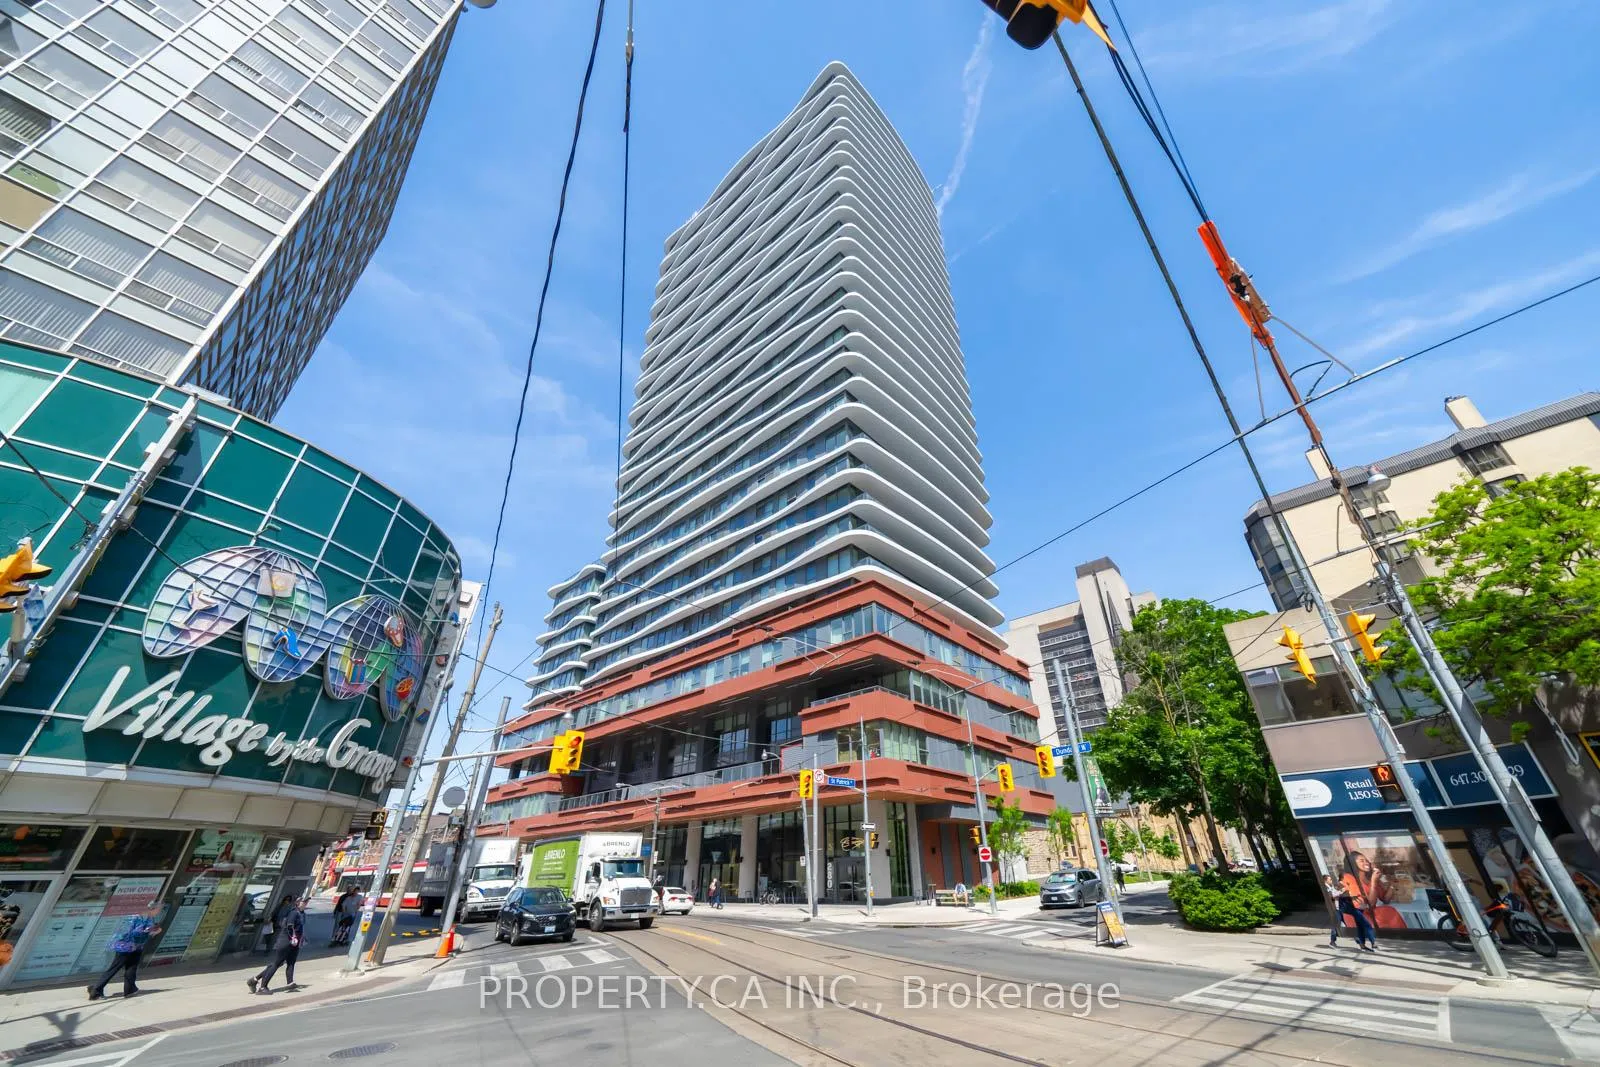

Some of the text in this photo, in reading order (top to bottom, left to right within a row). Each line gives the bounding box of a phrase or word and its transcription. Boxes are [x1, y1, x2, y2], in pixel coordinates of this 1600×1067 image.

[82, 665, 397, 794] Village by the Grange
[1344, 779, 1373, 791] Retail
[1348, 789, 1371, 801] 1,150
